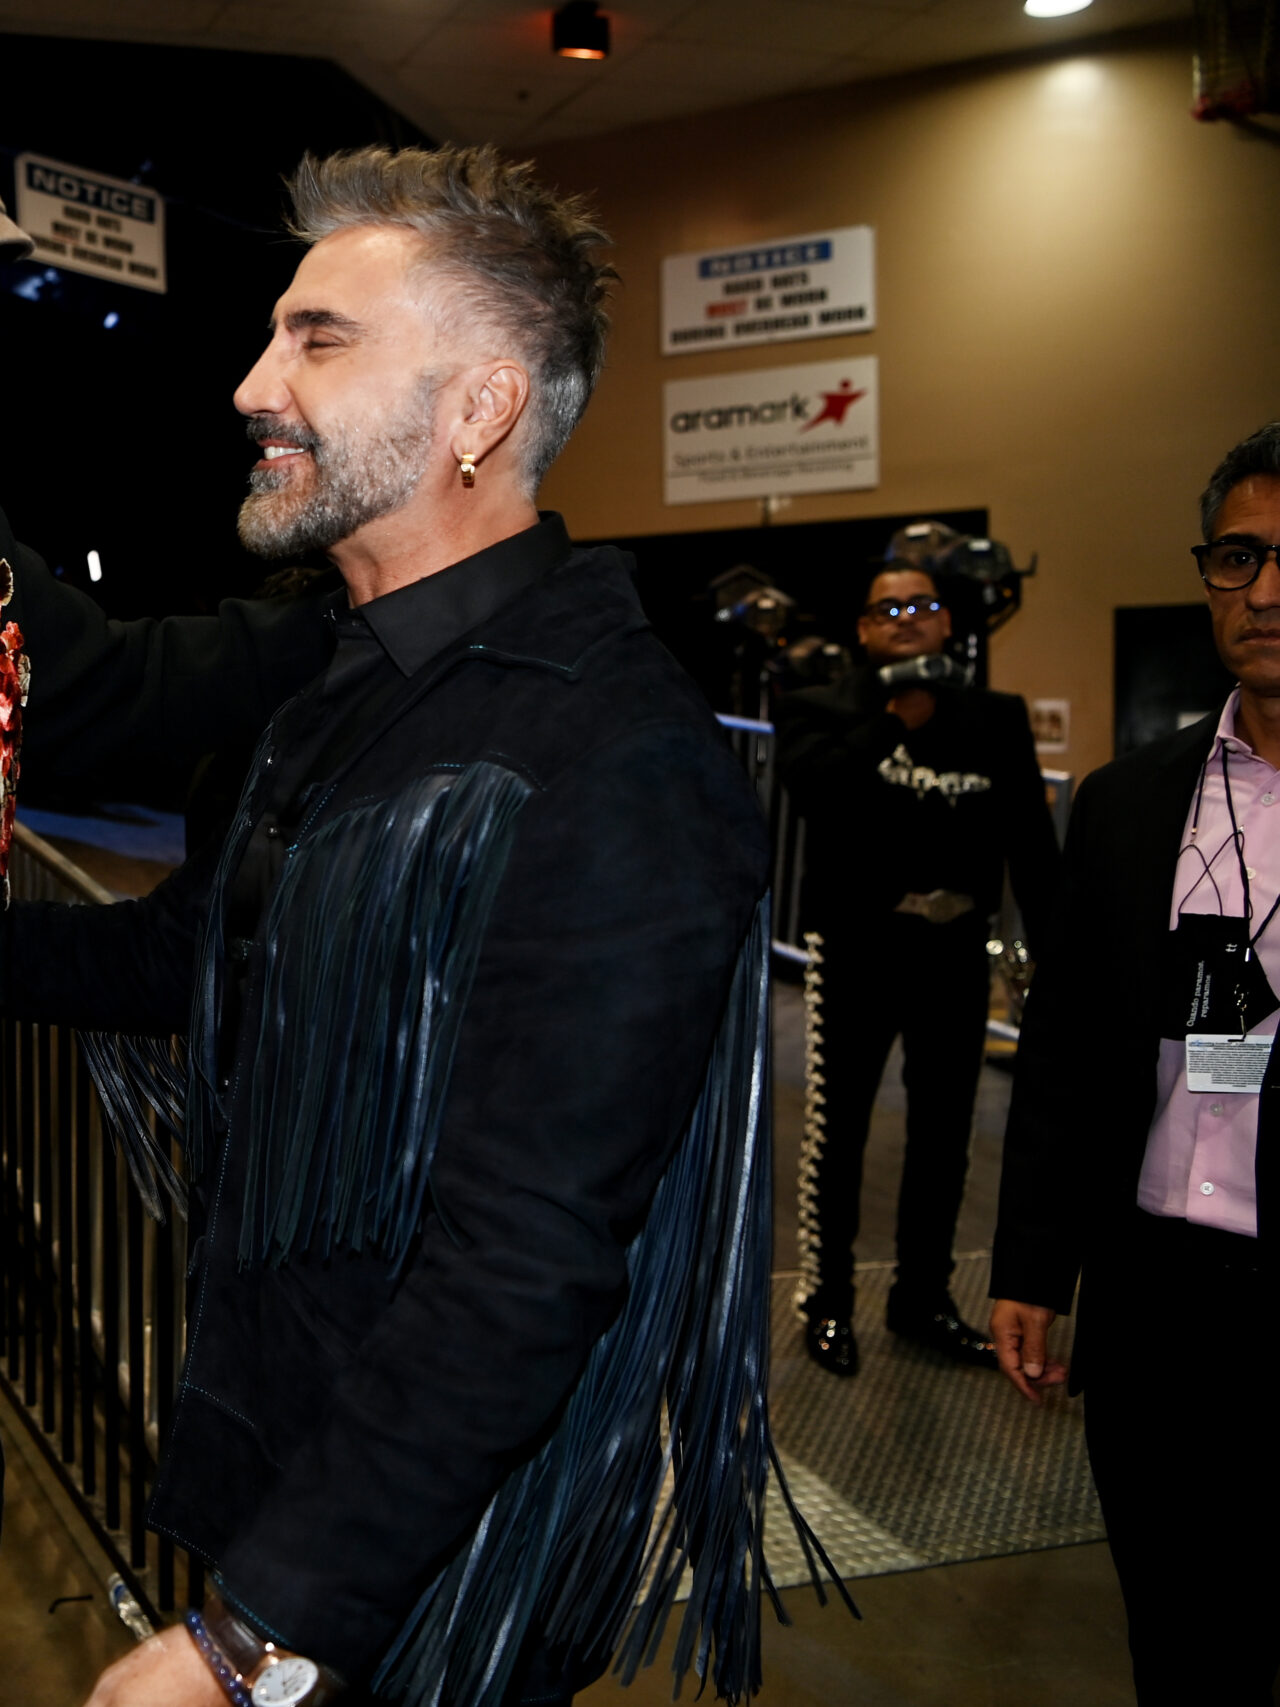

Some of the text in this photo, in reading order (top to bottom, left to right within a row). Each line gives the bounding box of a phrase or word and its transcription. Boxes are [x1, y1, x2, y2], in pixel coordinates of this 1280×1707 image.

[32, 168, 149, 220] NOTICE
[709, 244, 821, 277] NOTICE
[670, 393, 810, 433] aramark
[673, 435, 869, 468] Sports & Entertainment
[1186, 998, 1200, 1027] Cuando
